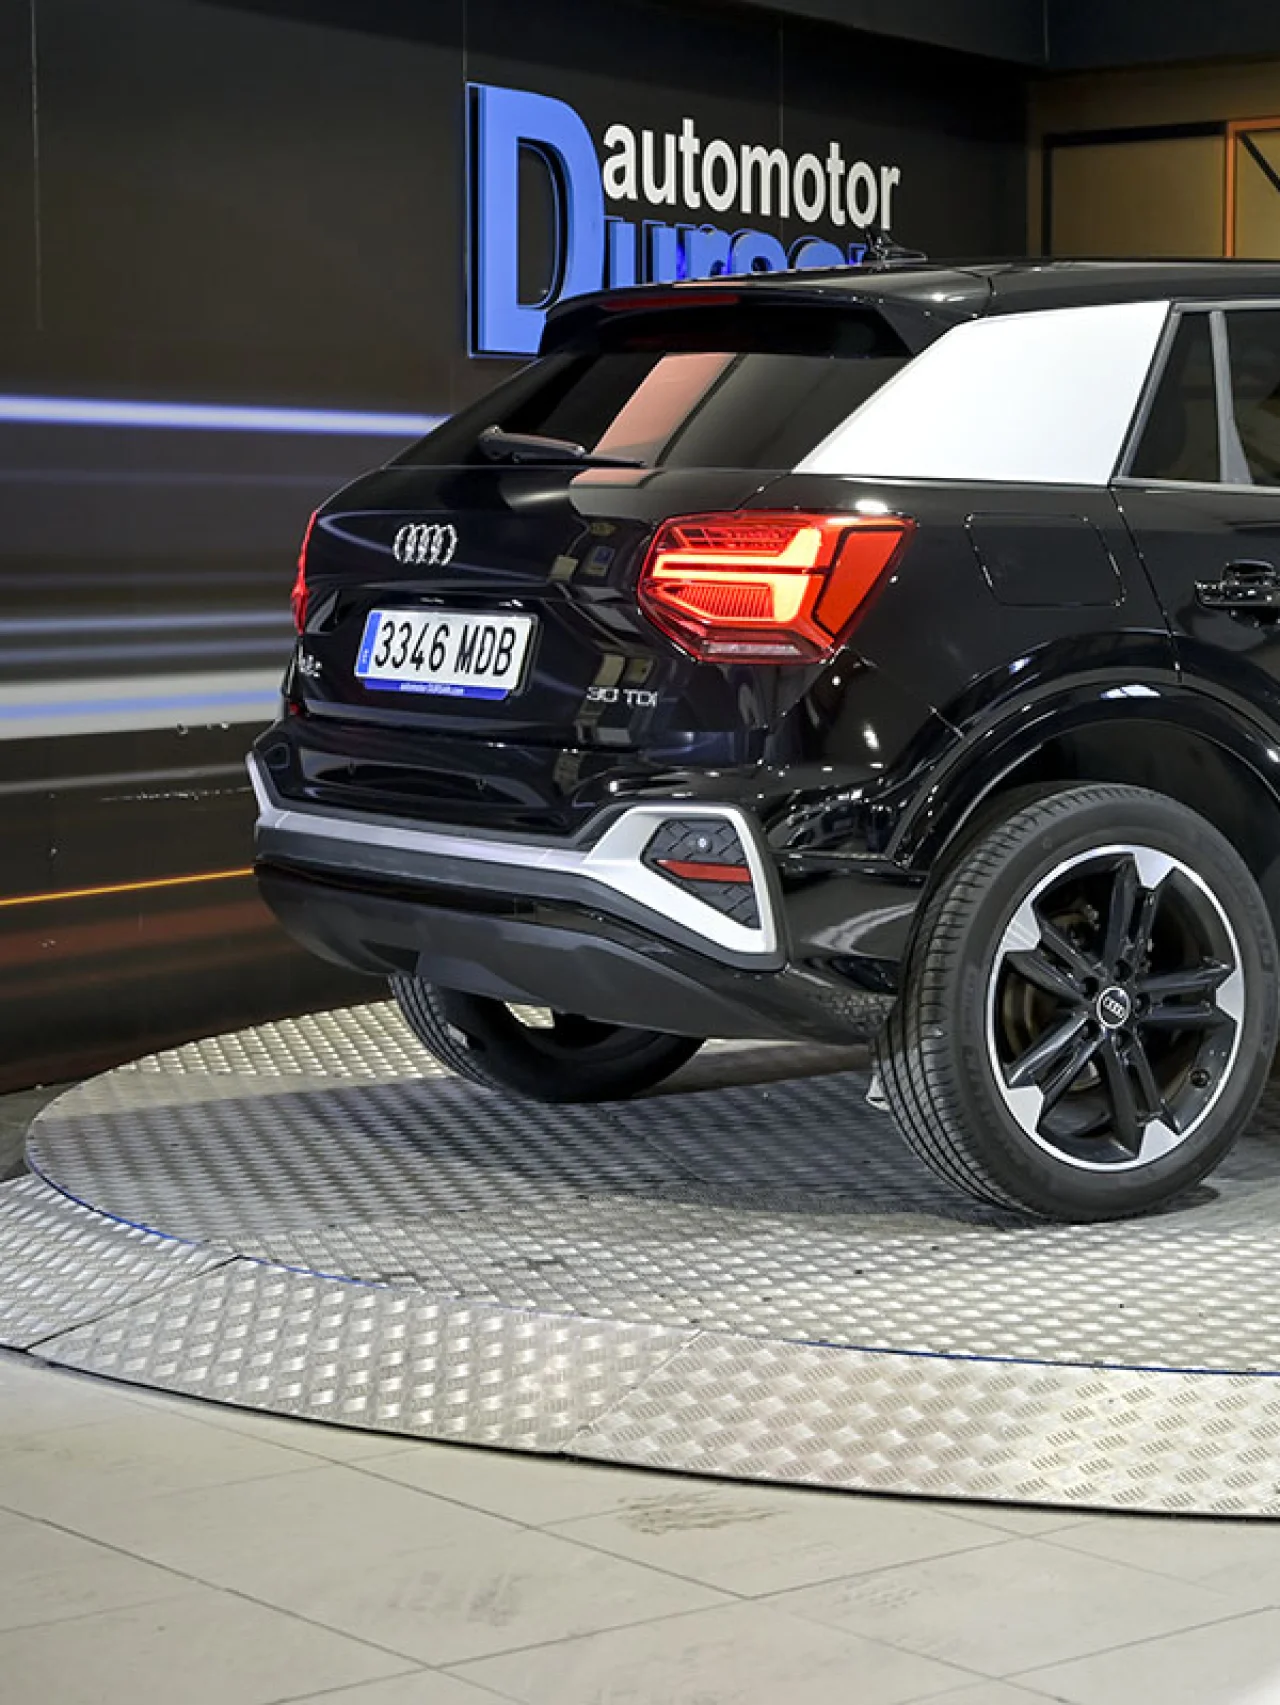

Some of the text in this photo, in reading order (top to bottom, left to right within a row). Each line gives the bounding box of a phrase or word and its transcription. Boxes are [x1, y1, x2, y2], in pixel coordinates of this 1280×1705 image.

[602, 118, 900, 230] automotor
[374, 620, 450, 672] 3346
[454, 624, 517, 677] MDB
[586, 686, 657, 707] 30 TDI
